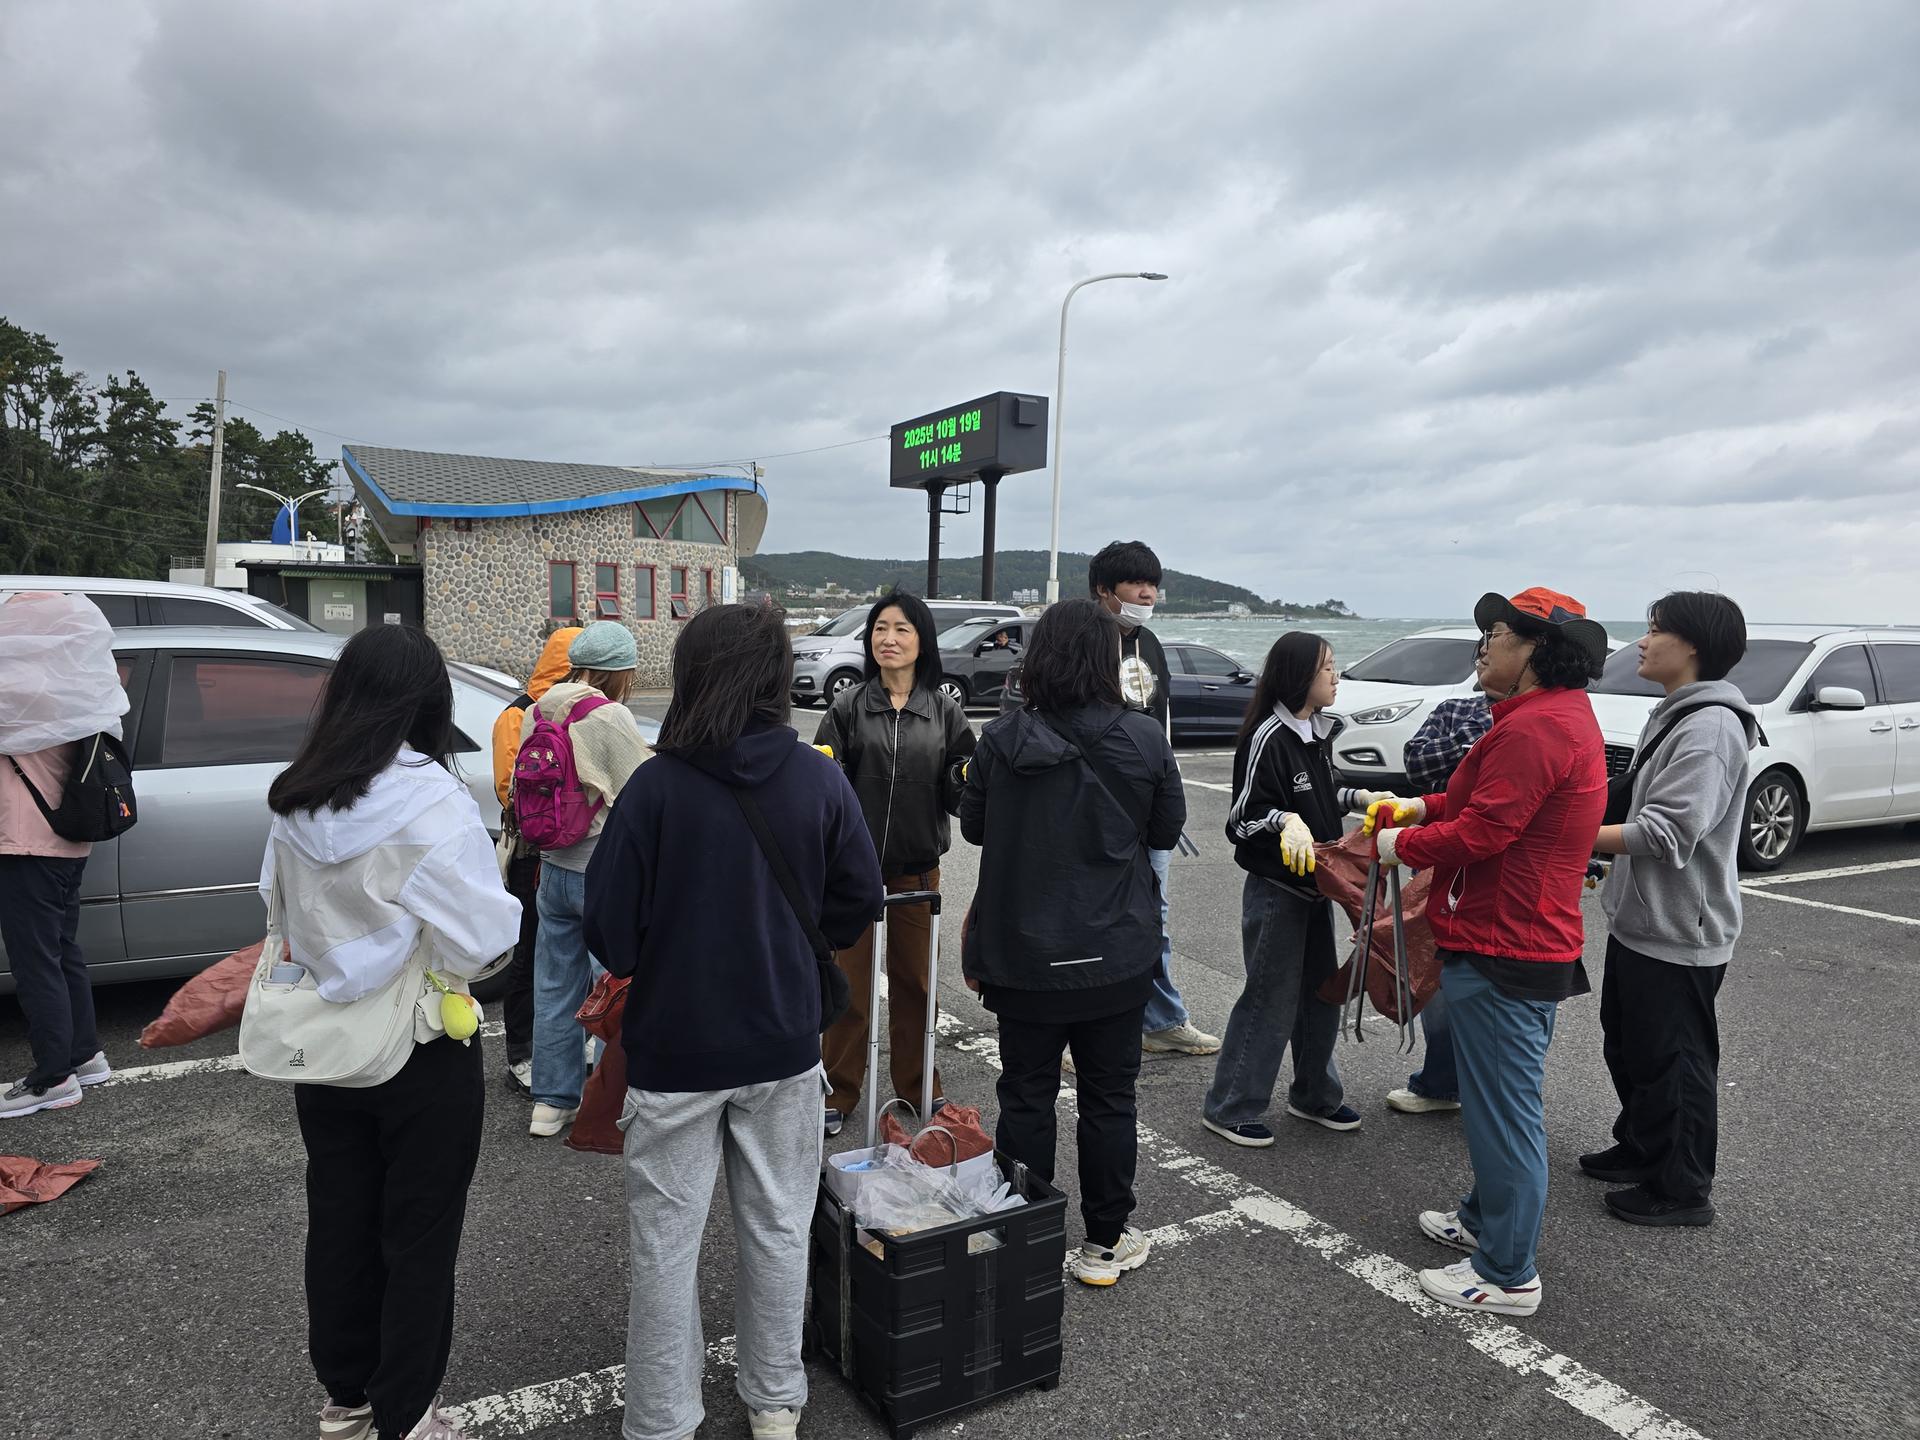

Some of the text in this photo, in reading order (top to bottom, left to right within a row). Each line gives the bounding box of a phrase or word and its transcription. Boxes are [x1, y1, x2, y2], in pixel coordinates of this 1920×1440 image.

[904, 410, 981, 448] 2025년 10월 19일
[920, 442, 961, 469] 11시 14분
